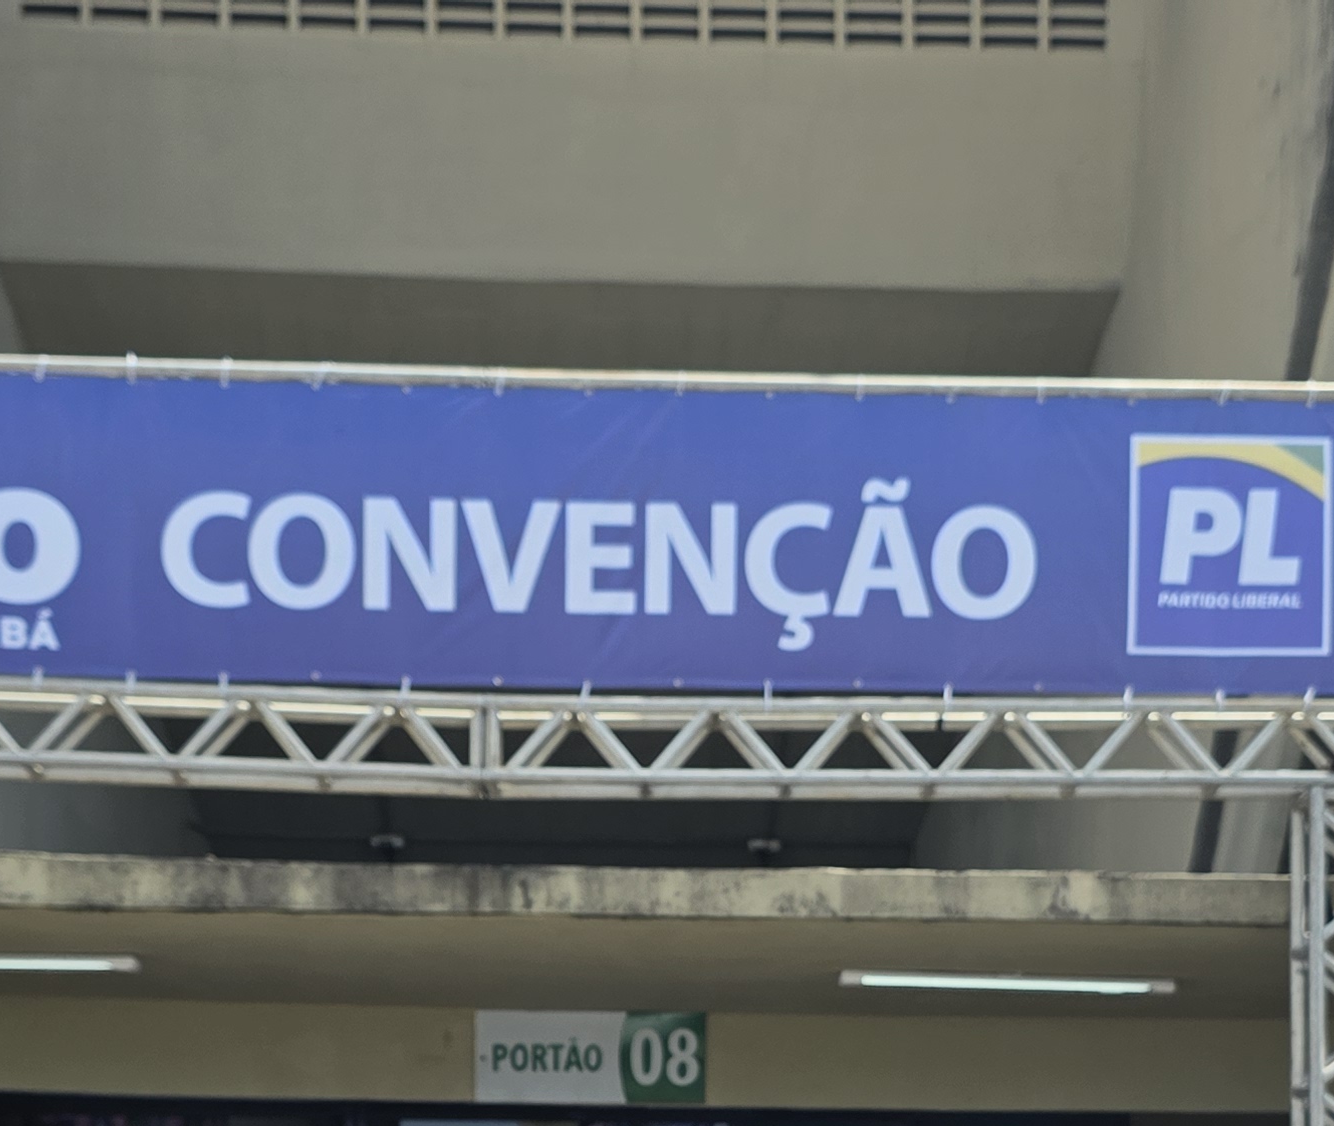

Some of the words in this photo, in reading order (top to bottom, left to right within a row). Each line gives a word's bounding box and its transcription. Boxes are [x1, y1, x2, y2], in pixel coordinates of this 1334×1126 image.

[160, 476, 1038, 652] CONVENÇÃO
[1159, 486, 1302, 587] PL
[1157, 591, 1231, 610] PARTIDO
[1232, 592, 1302, 610] LIBERAL
[491, 1036, 603, 1074] PORTÃO
[630, 1027, 700, 1087] 08
